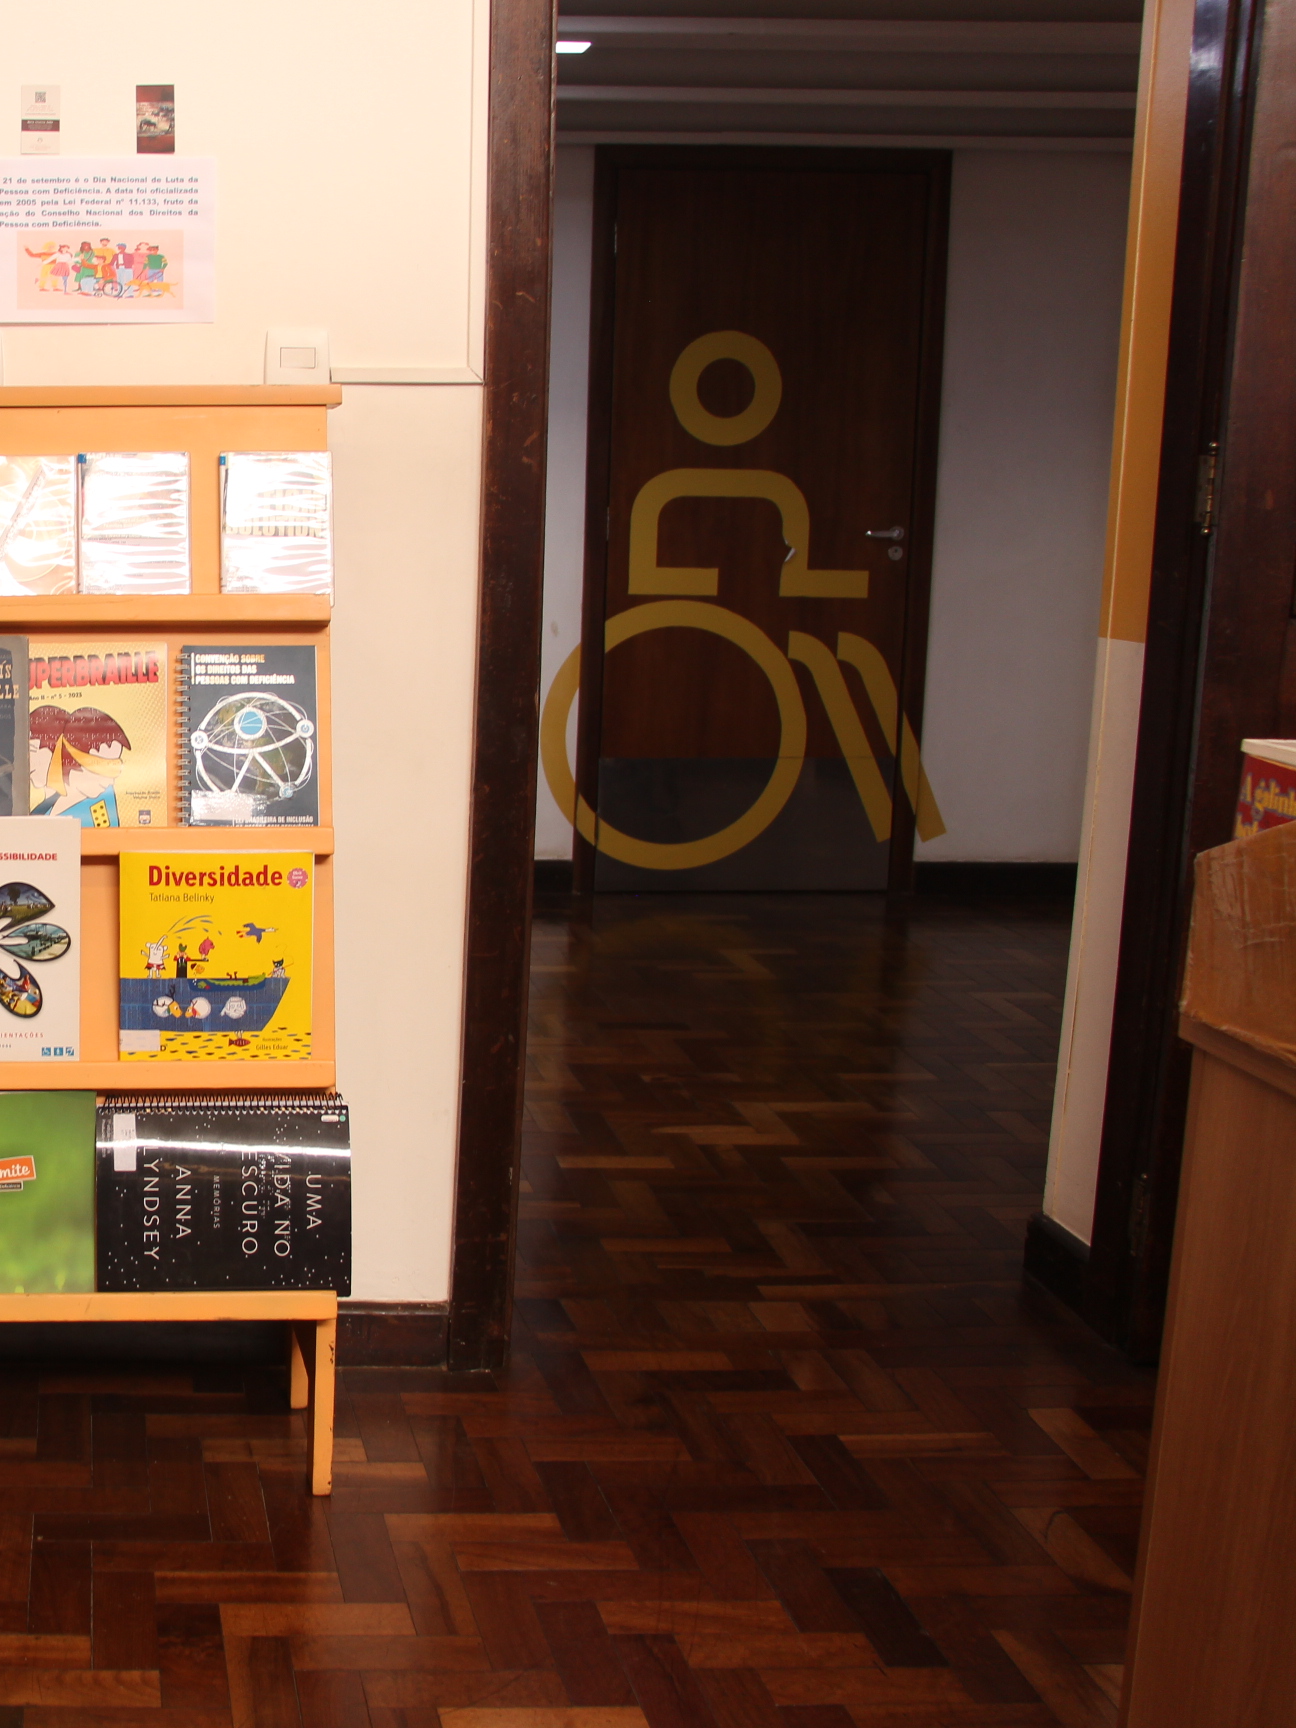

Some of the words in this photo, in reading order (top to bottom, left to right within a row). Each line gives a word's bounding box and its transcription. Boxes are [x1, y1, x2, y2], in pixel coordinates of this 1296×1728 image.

[2, 176, 12, 184] 21
[17, 176, 27, 184] de
[31, 176, 71, 184] setembro
[93, 176, 106, 184] Dia
[110, 176, 147, 184] Nacional
[151, 176, 161, 184] de
[165, 176, 184, 184] Luta
[188, 176, 198, 184] da
[0, 187, 29, 196] Pessoa
[32, 187, 50, 196] com
[106, 187, 112, 196] A
[115, 187, 133, 196] data
[136, 187, 147, 196] foi
[150, 187, 198, 196] oficializada
[0, 198, 12, 207] em
[16, 198, 37, 207] 2005
[41, 198, 59, 207] pela
[63, 198, 76, 207] Lei
[80, 198, 111, 207] Federal
[163, 198, 183, 207] fruto
[188, 198, 198, 207] da
[0, 209, 19, 218] ação
[25, 209, 36, 218] do
[41, 209, 80, 218] Conselho
[85, 209, 123, 218] Nacional
[129, 209, 143, 218] dos
[149, 209, 182, 218] Direitos
[188, 209, 198, 218] da
[0, 220, 29, 228] Pessoa
[32, 220, 50, 228] com
[195, 653, 239, 664] CONVENÇÃO
[241, 654, 265, 663] SOBRE
[195, 664, 206, 674] OS
[207, 664, 240, 674] DIREITOS
[241, 664, 257, 674] DAS
[195, 675, 230, 685] PESSOAS
[230, 675, 248, 685] COM
[249, 673, 295, 685] DEFICIÊNCIA
[148, 864, 283, 887] Diversidade
[149, 892, 181, 902] Tatiana
[182, 892, 215, 904] Belinky
[143, 1146, 160, 1261] LYNDSEY
[175, 1165, 192, 1238] ANNA
[213, 1174, 221, 1230] MEMÓRIAS
[305, 1174, 322, 1230] UMA
[274, 1219, 291, 1257] NO
